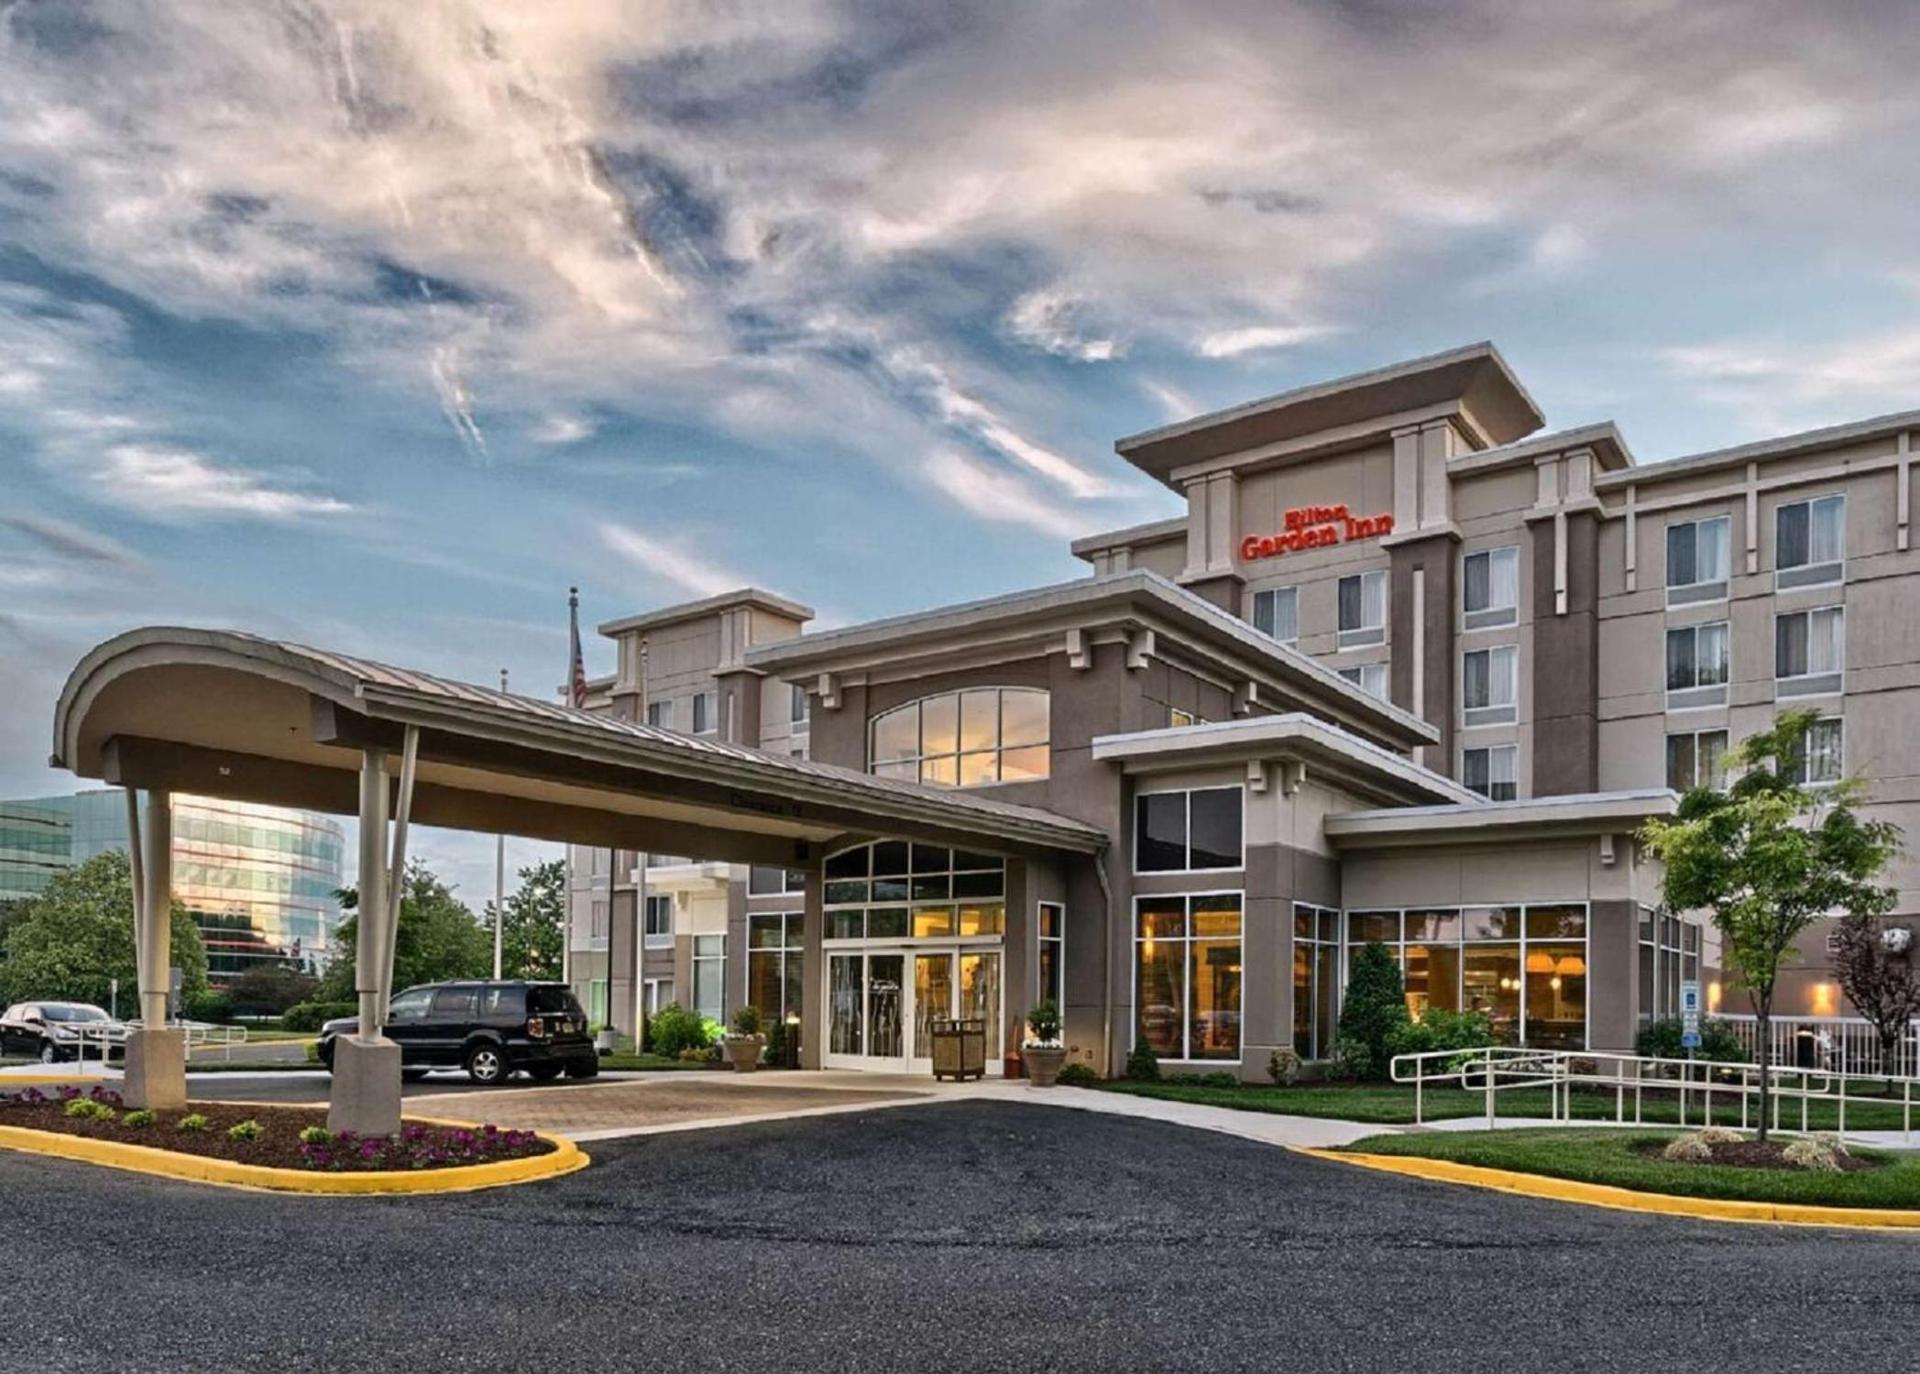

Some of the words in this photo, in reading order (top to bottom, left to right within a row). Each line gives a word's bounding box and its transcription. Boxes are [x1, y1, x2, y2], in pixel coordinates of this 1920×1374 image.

[1285, 504, 1348, 530] Hilton
[1241, 525, 1339, 560] Garden
[1344, 512, 1394, 541] Inn
